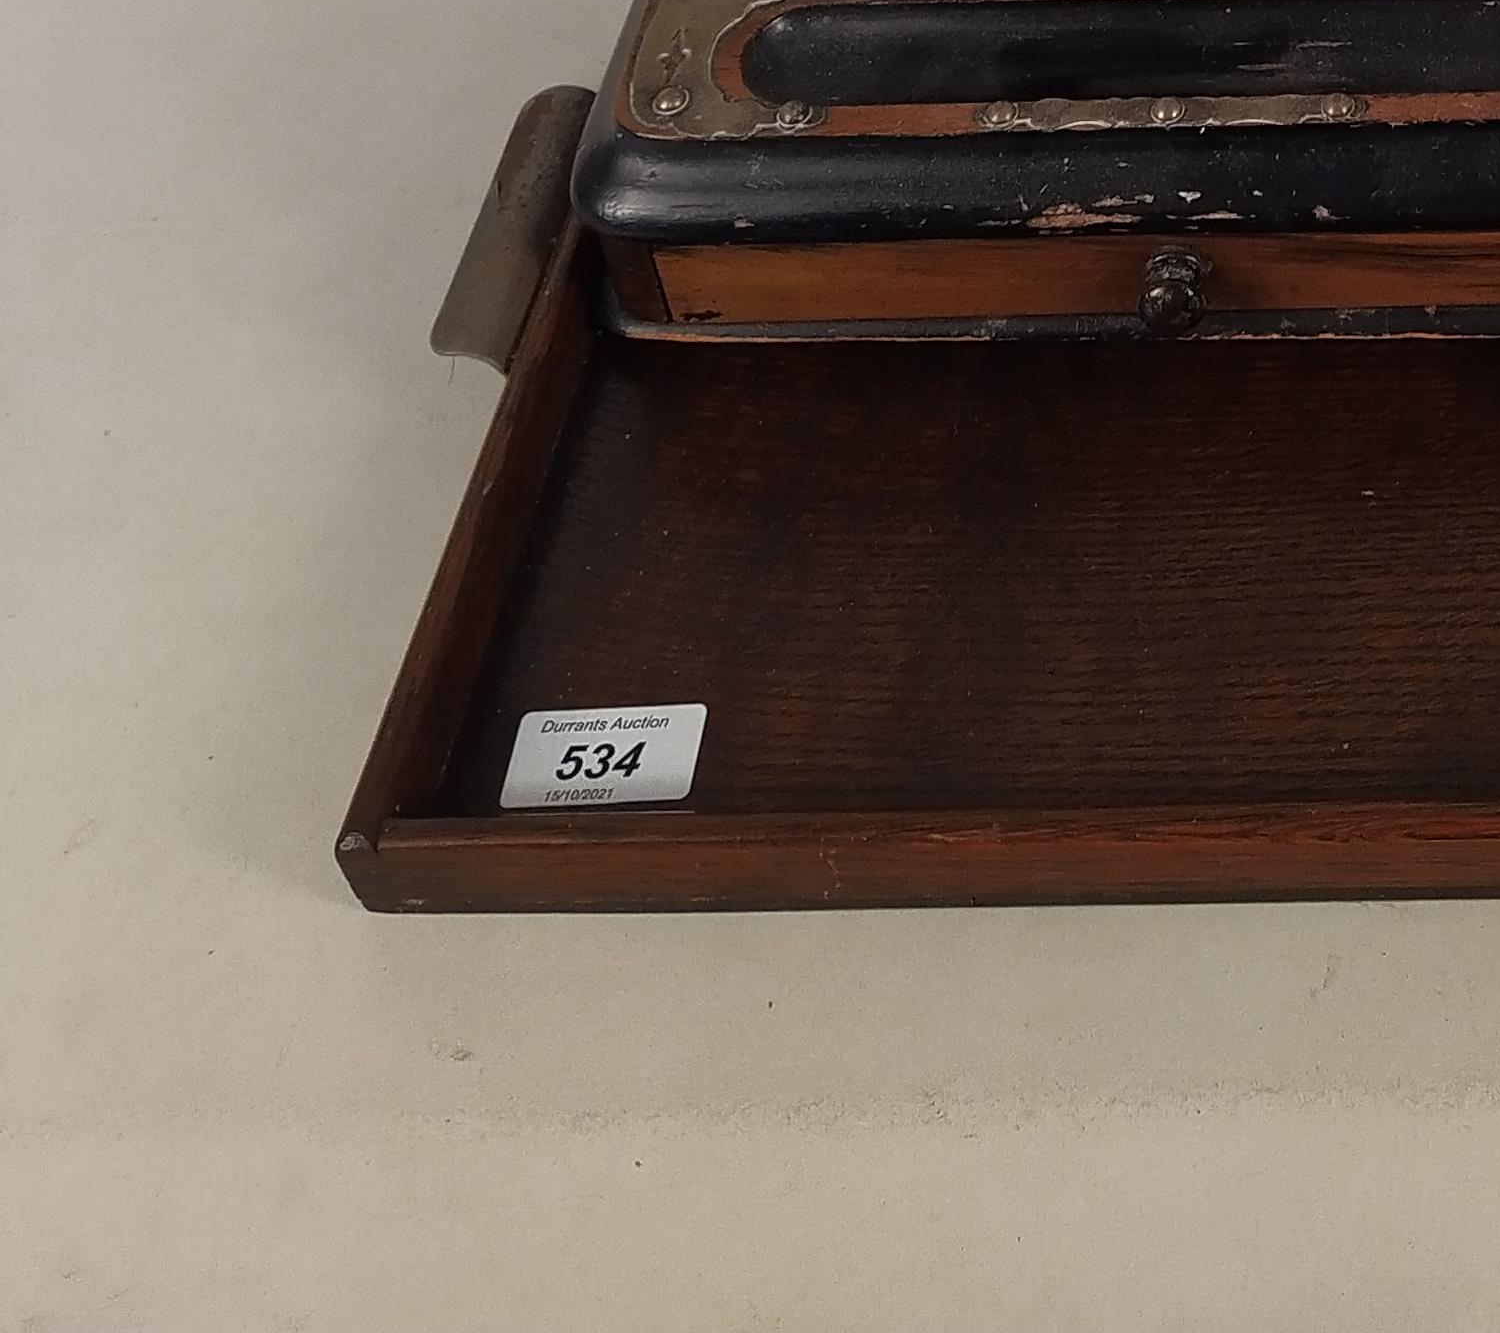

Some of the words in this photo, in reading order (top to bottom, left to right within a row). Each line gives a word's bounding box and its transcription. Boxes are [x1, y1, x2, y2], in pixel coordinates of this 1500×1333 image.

[541, 718, 608, 734] Durrants
[610, 715, 670, 731] Auction
[555, 741, 647, 780] 534
[544, 787, 614, 803] 15/10/2021
